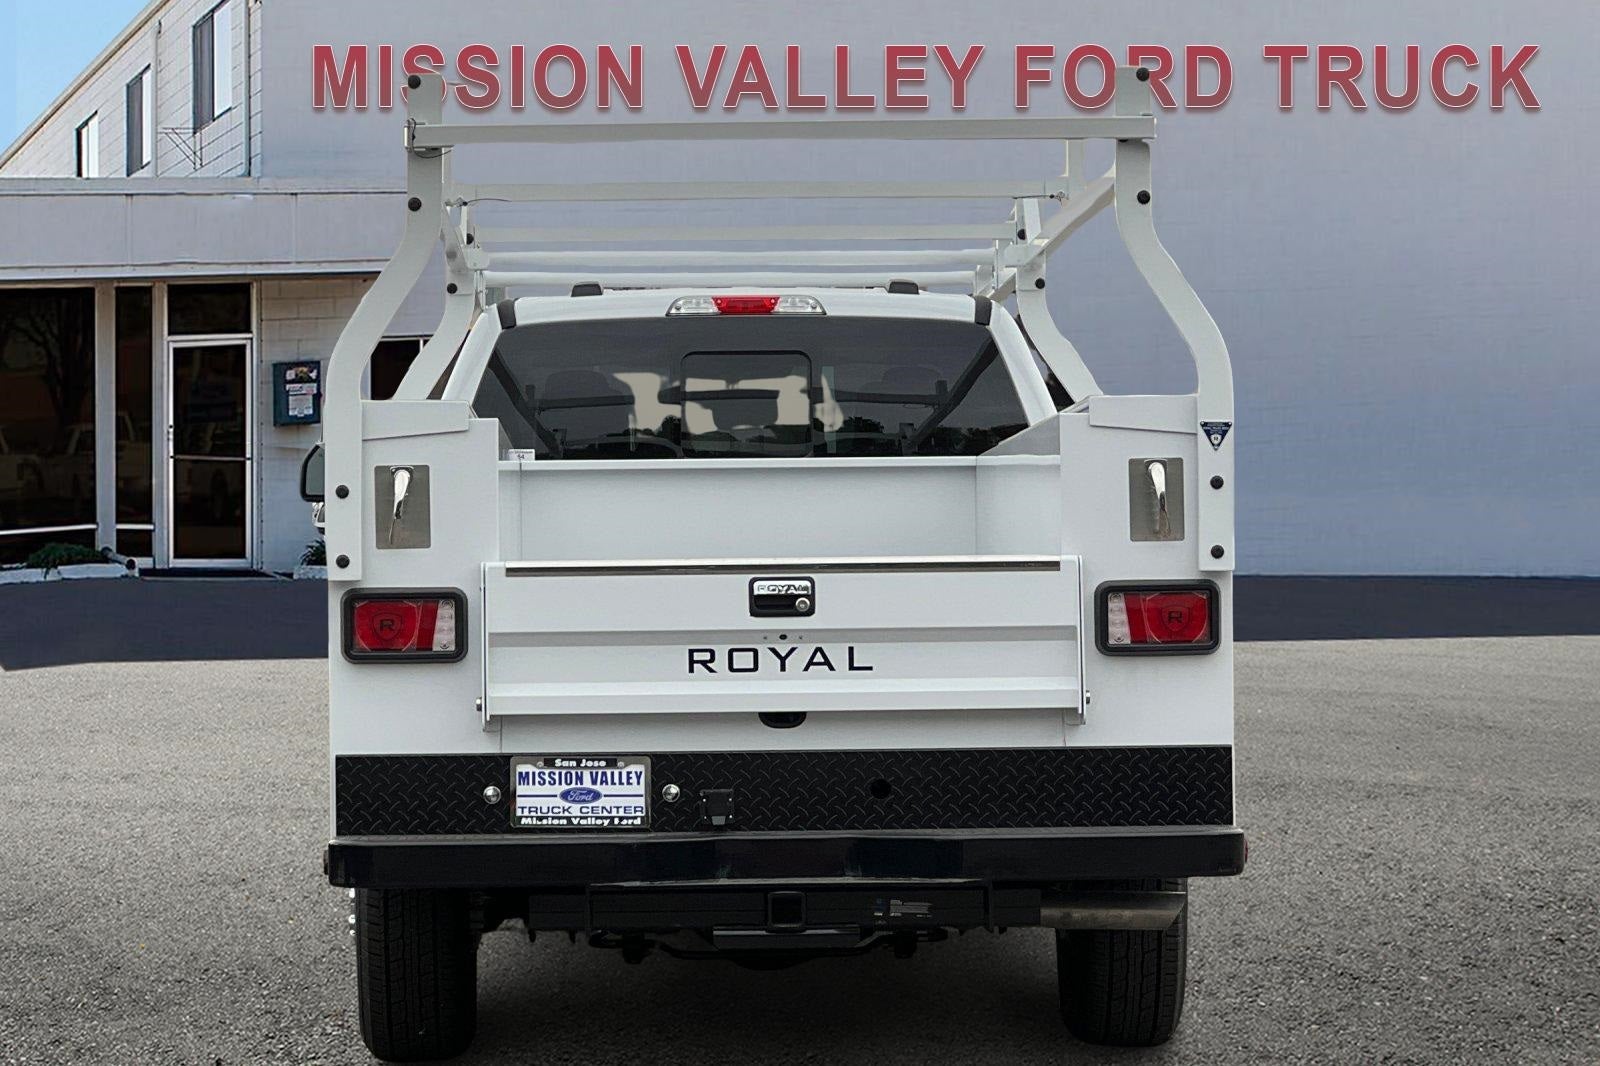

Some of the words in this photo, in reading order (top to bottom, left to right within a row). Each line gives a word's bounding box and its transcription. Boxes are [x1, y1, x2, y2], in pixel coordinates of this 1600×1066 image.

[675, 44, 985, 107] VALLEY
[1015, 44, 1233, 108] FORD
[1263, 44, 1541, 108] TRUCK
[379, 620, 395, 631] R
[688, 646, 873, 673] ROYAL
[554, 758, 577, 767] San
[580, 758, 607, 767] Jose
[518, 771, 583, 786] MISSION
[589, 770, 643, 786] VALLEY
[567, 790, 594, 801] Ford
[517, 805, 573, 815] TRUCK
[579, 805, 644, 815] CENTER
[571, 816, 610, 827] Valley
